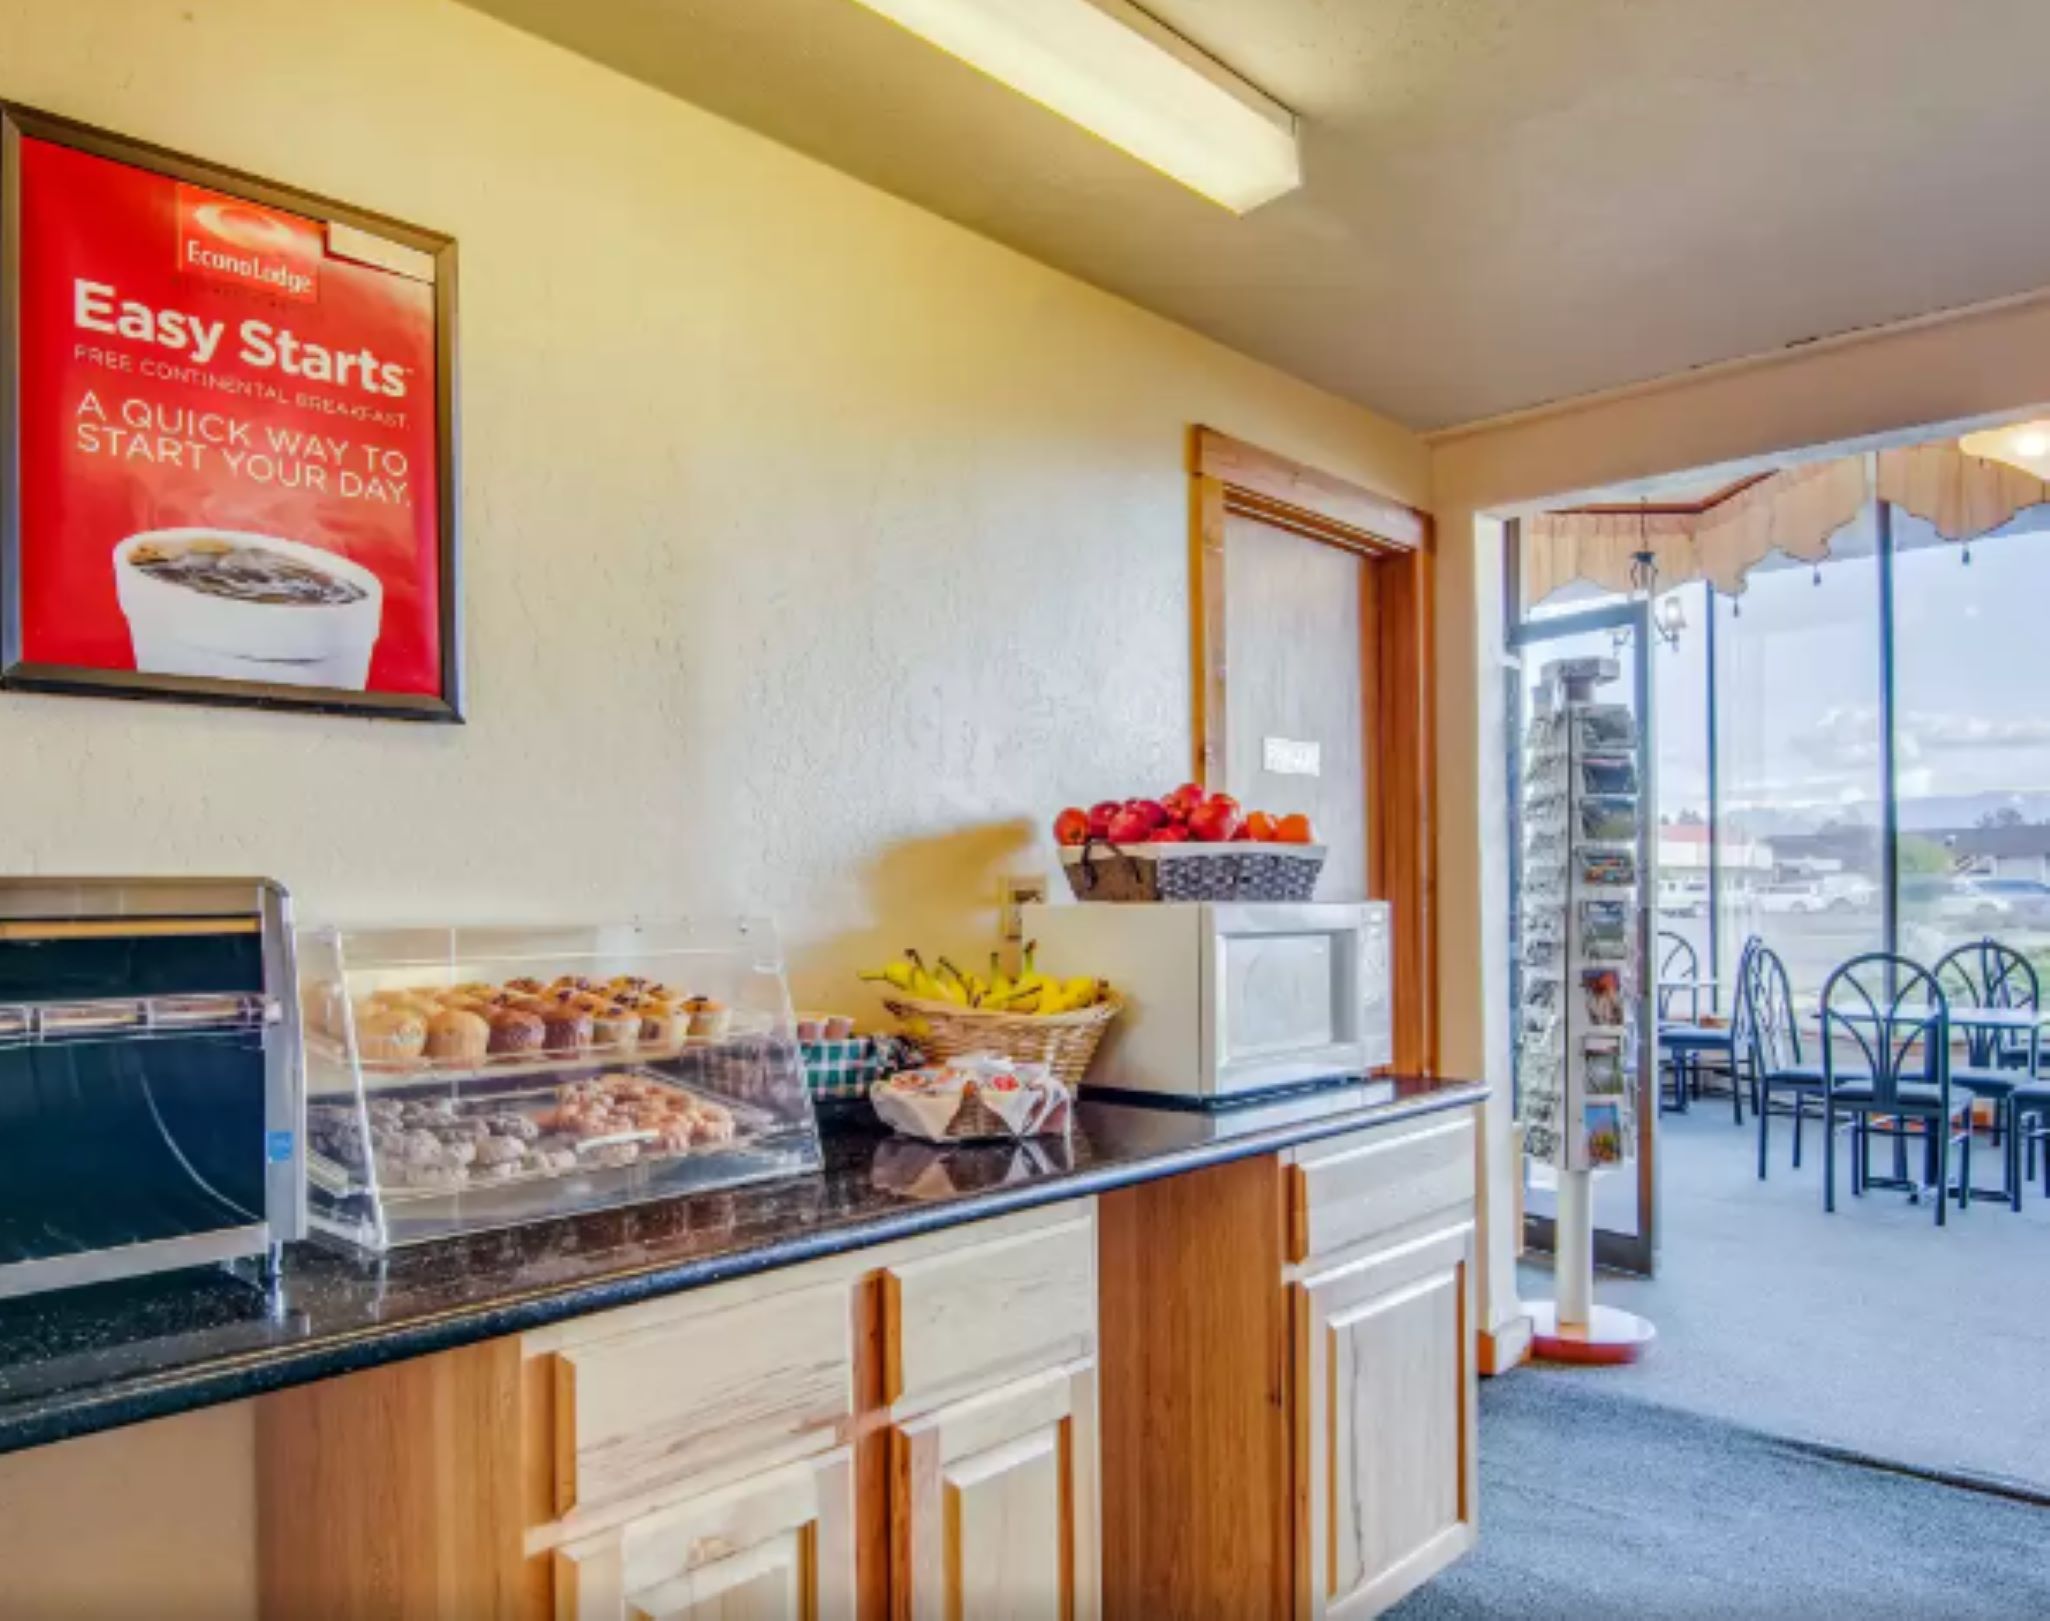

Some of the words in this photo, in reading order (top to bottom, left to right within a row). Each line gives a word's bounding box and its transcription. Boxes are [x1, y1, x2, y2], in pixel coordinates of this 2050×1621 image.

[73, 278, 225, 364] Easy
[73, 344, 133, 373] FREE
[139, 358, 289, 404] CONTINENTAL
[77, 389, 107, 422] A
[122, 398, 251, 449] QUICK
[265, 425, 350, 466] WAY
[361, 444, 408, 478] TO
[77, 423, 208, 472] START
[223, 447, 328, 496] YOUR
[340, 470, 411, 507] DAY.
